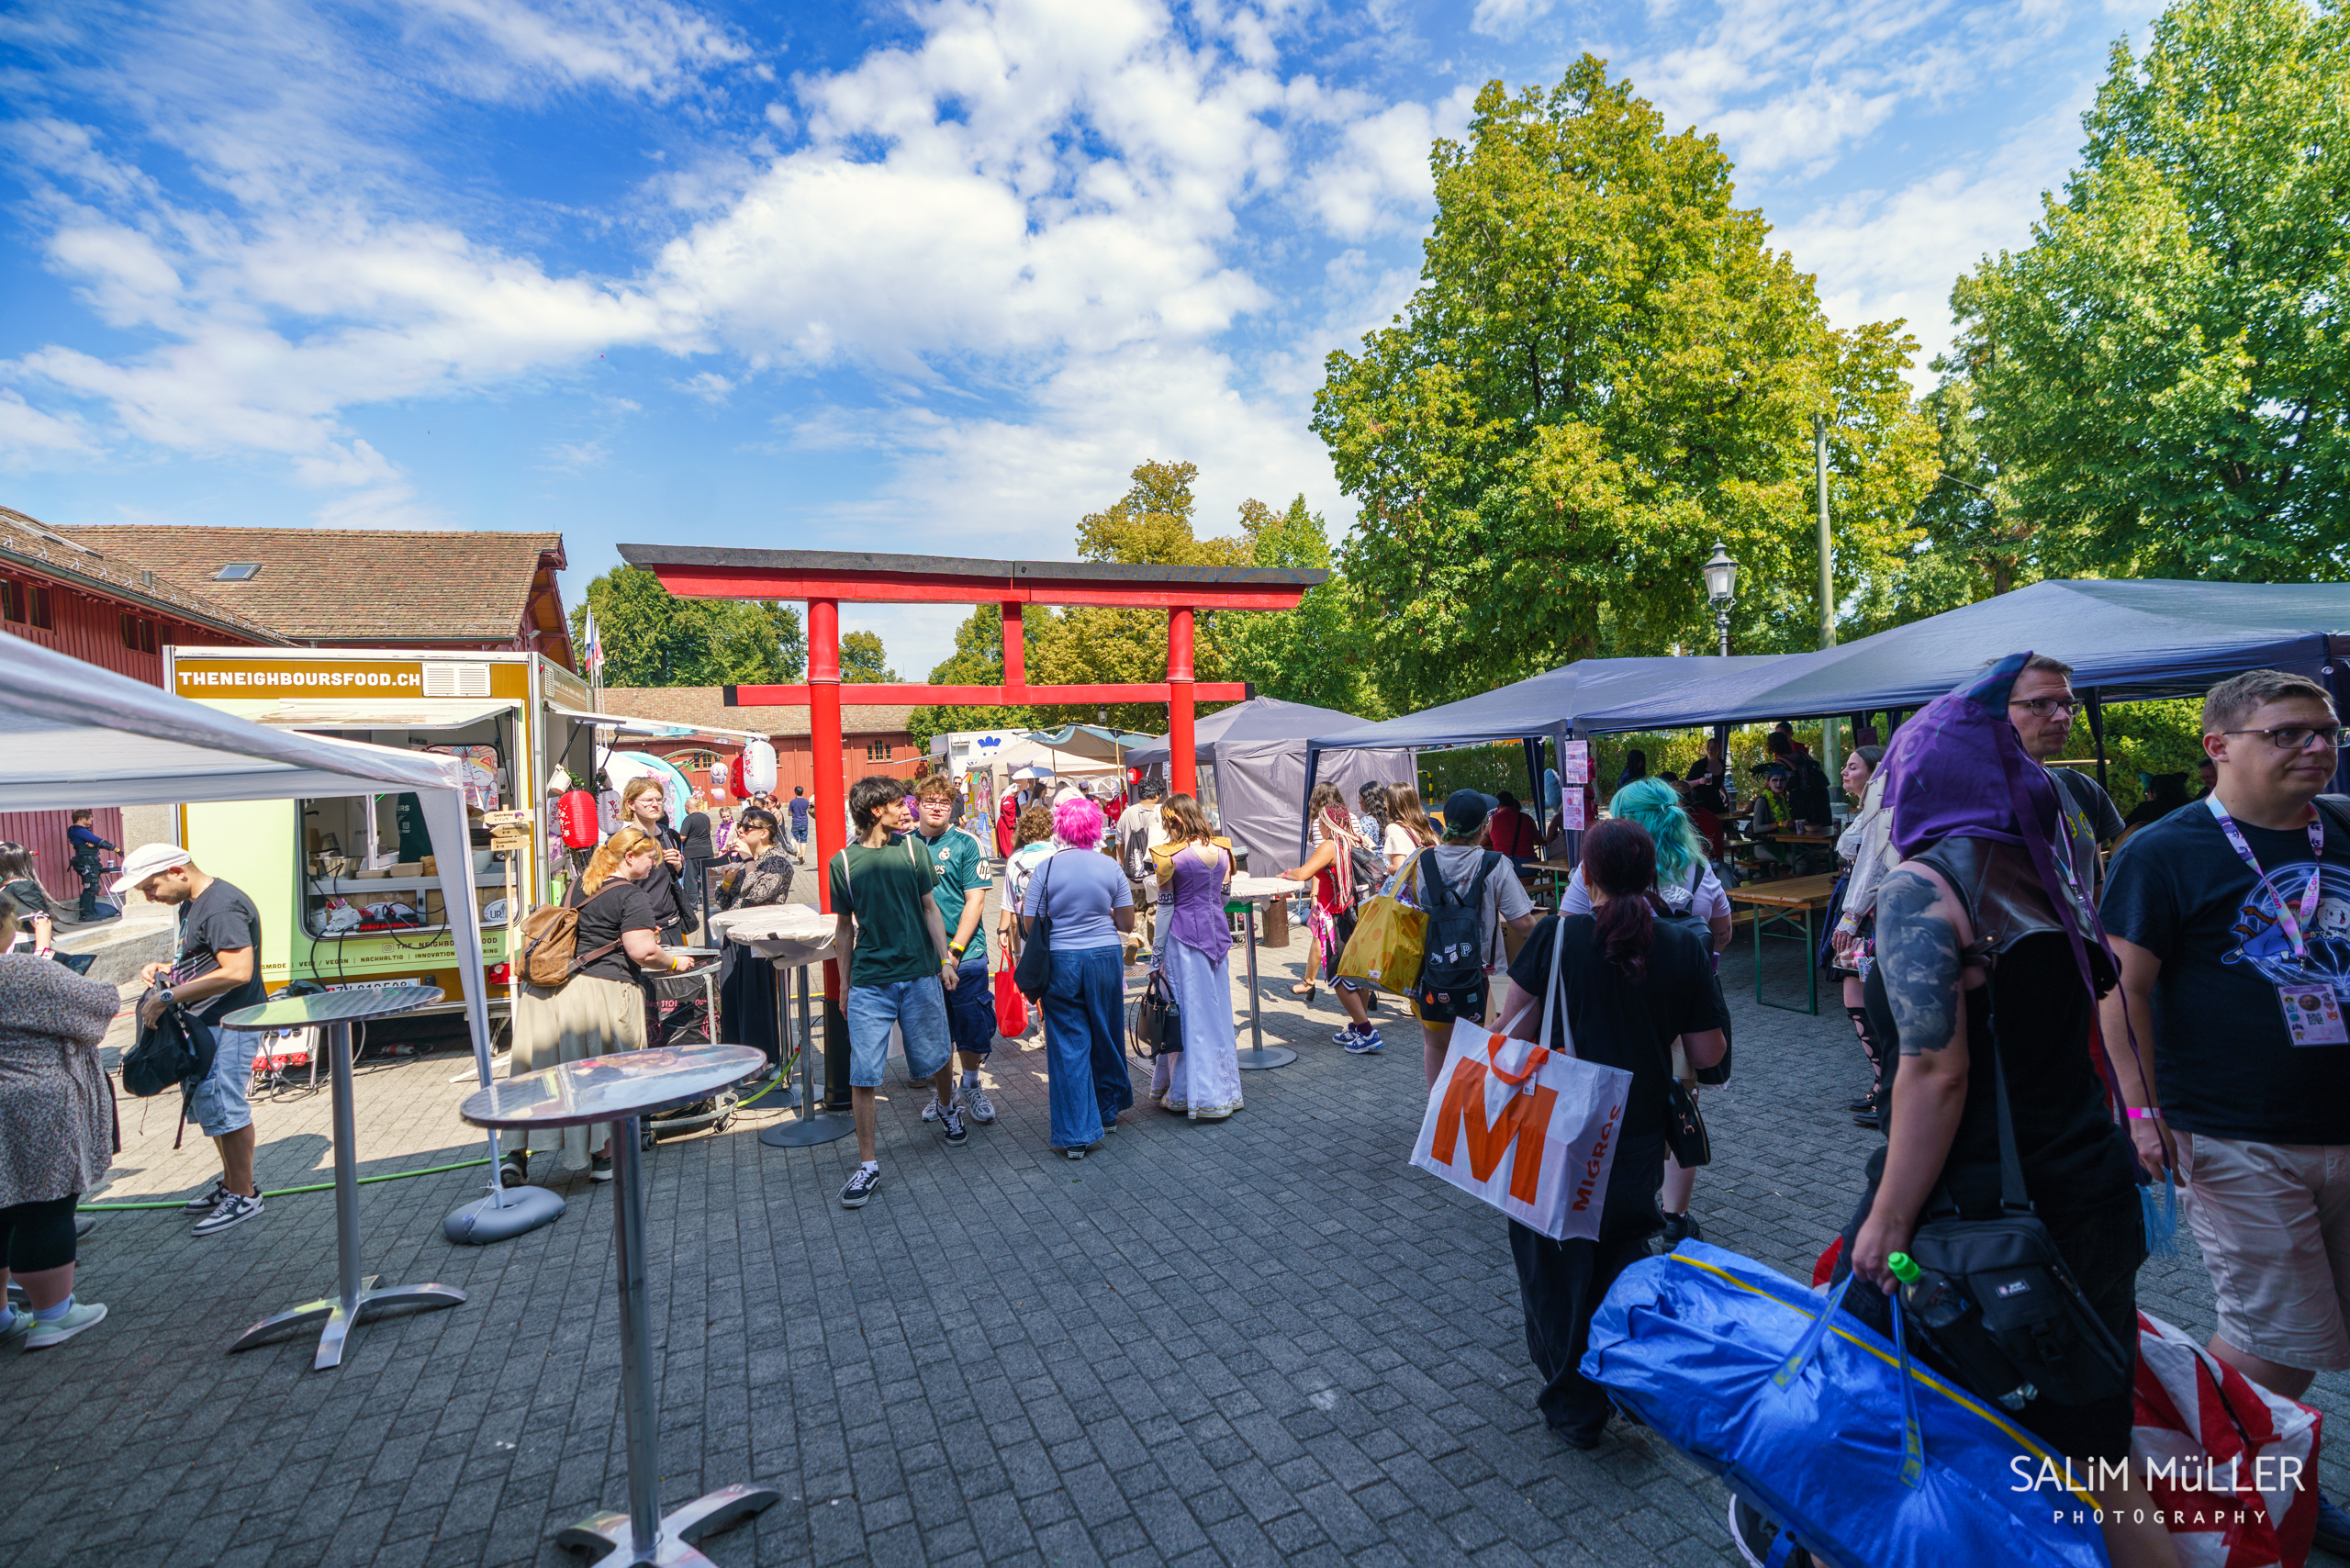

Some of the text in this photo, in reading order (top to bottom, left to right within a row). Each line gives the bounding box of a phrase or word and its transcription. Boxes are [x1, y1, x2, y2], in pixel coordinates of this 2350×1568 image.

[178, 671, 420, 687] THENEIGHBOURSFOOD.CH
[2301, 874, 2318, 917] Chibi-Con
[419, 940, 455, 948] NEIGHBO
[260, 962, 287, 970] SMADE
[360, 954, 405, 963] NACHHALTIG
[415, 950, 456, 958] INNOVATION
[1429, 1055, 1560, 1207] M
[1571, 1103, 1622, 1213] MIGROS
